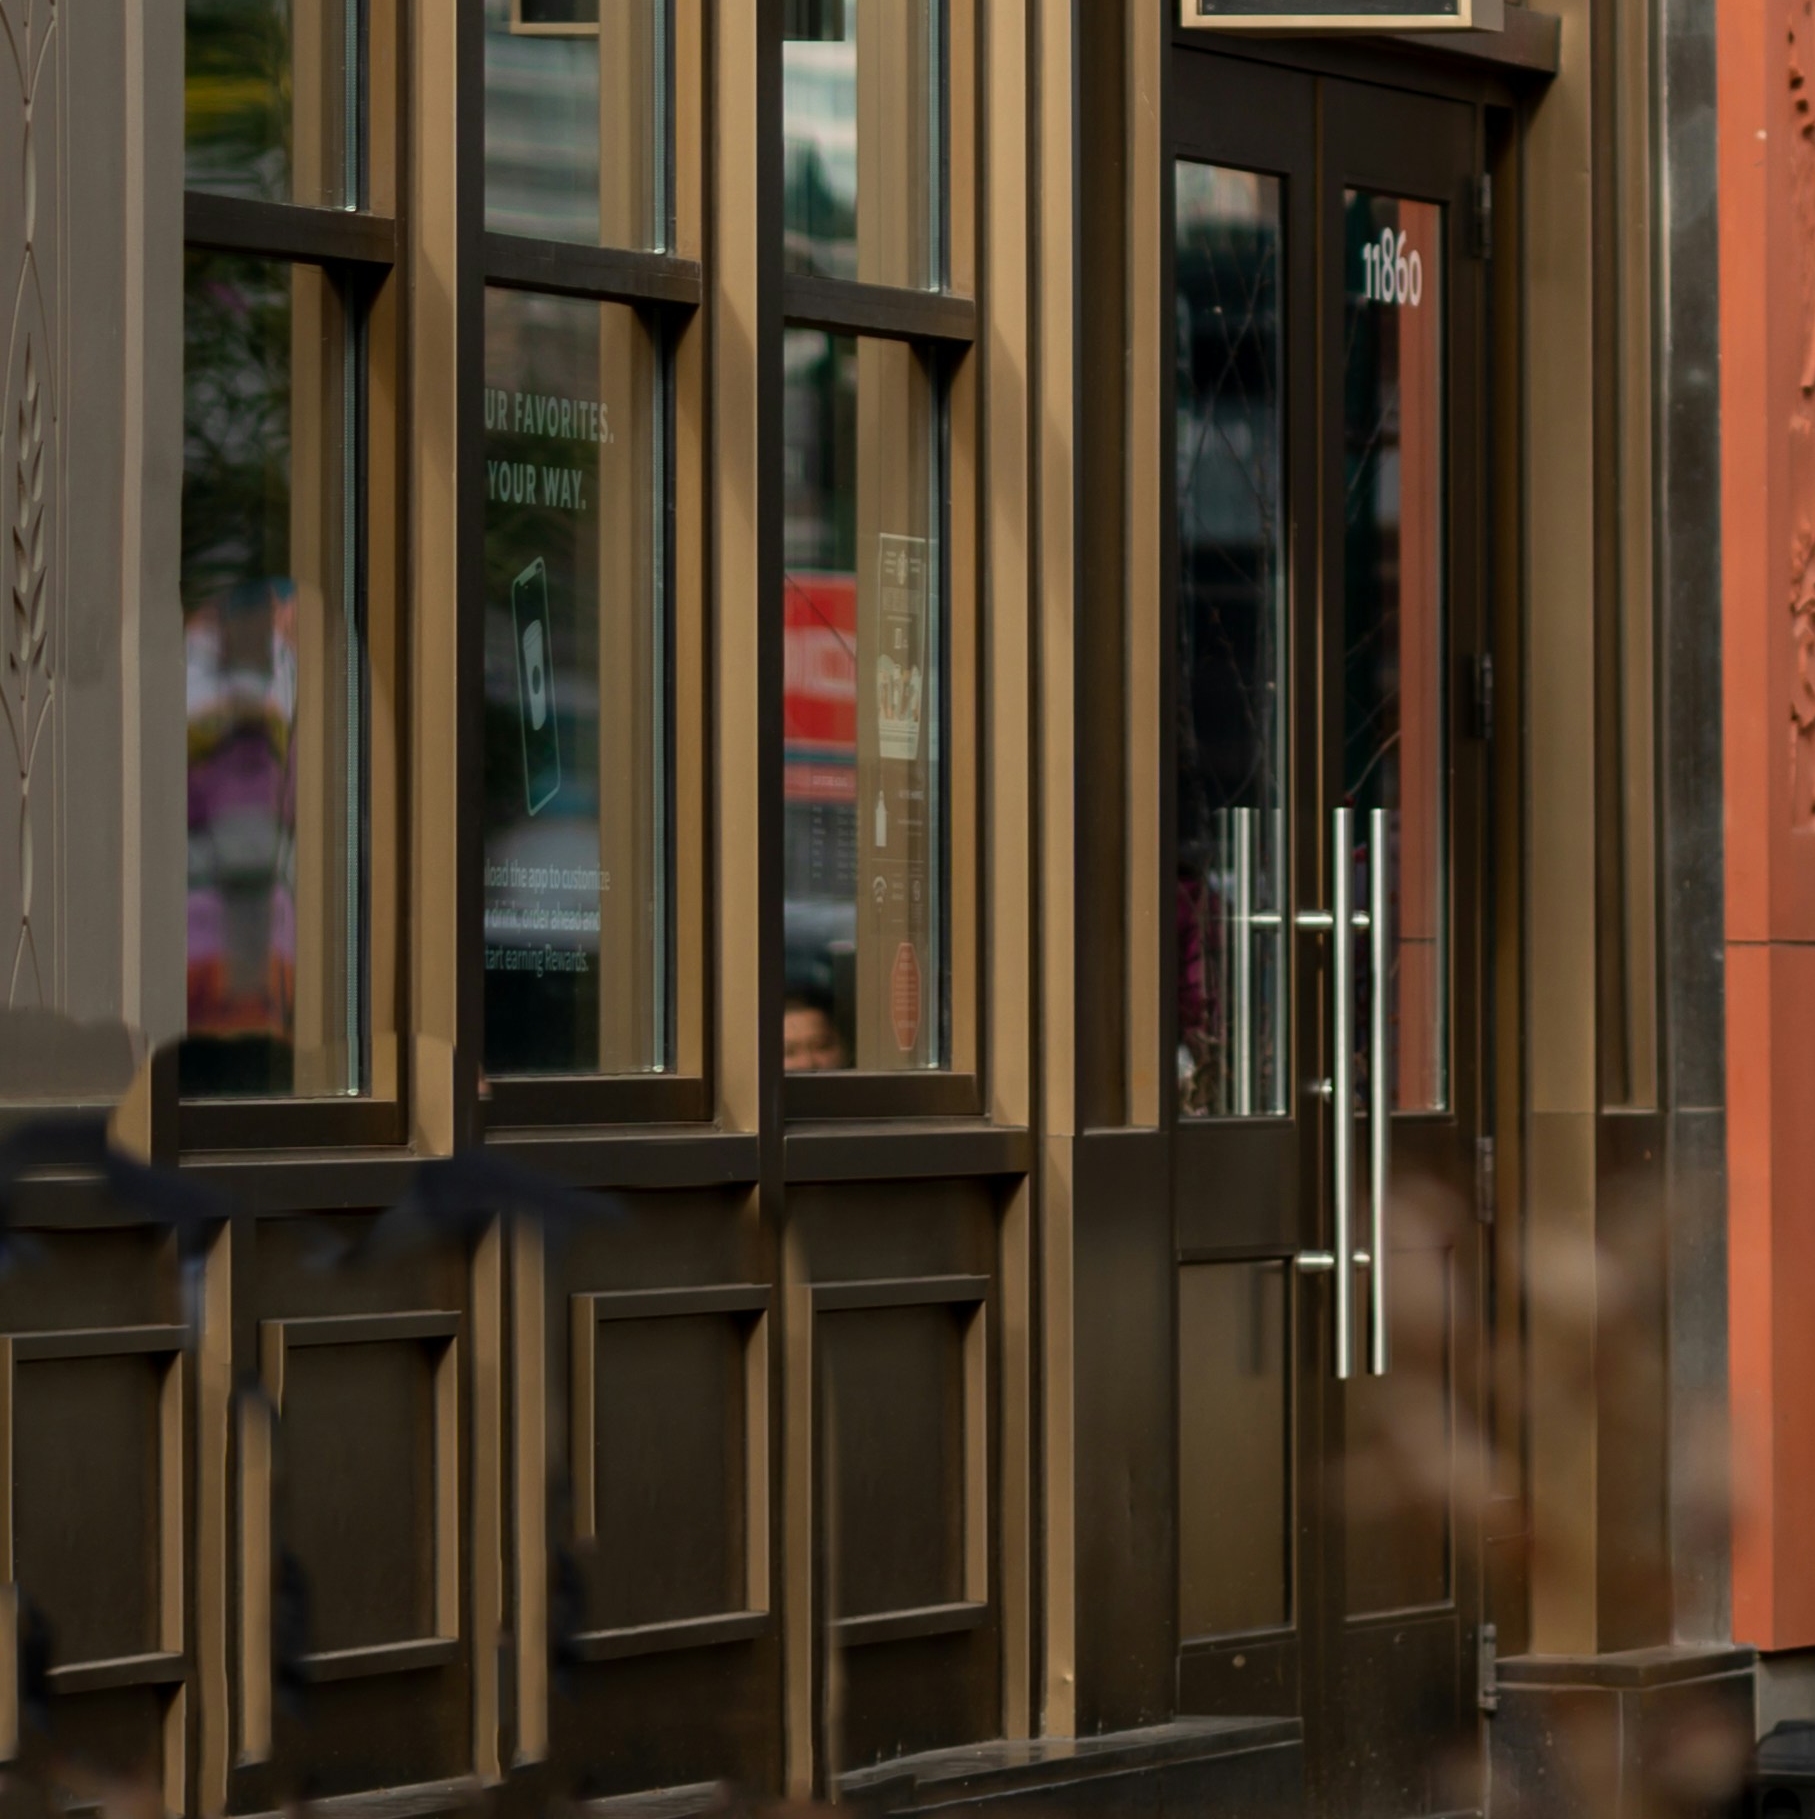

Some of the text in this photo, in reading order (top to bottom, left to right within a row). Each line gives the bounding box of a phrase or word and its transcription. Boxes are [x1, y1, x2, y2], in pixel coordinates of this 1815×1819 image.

[1363, 226, 1424, 308] 11860
[514, 392, 615, 444] FAVORITES.
[487, 460, 587, 510] YOUR WAY.
[510, 859, 527, 888] the
[528, 867, 548, 894] app
[549, 864, 561, 889] to
[562, 864, 611, 891] customize
[523, 901, 549, 930] order
[551, 901, 582, 931] ahead
[485, 945, 504, 970] tart
[505, 942, 544, 978] earning
